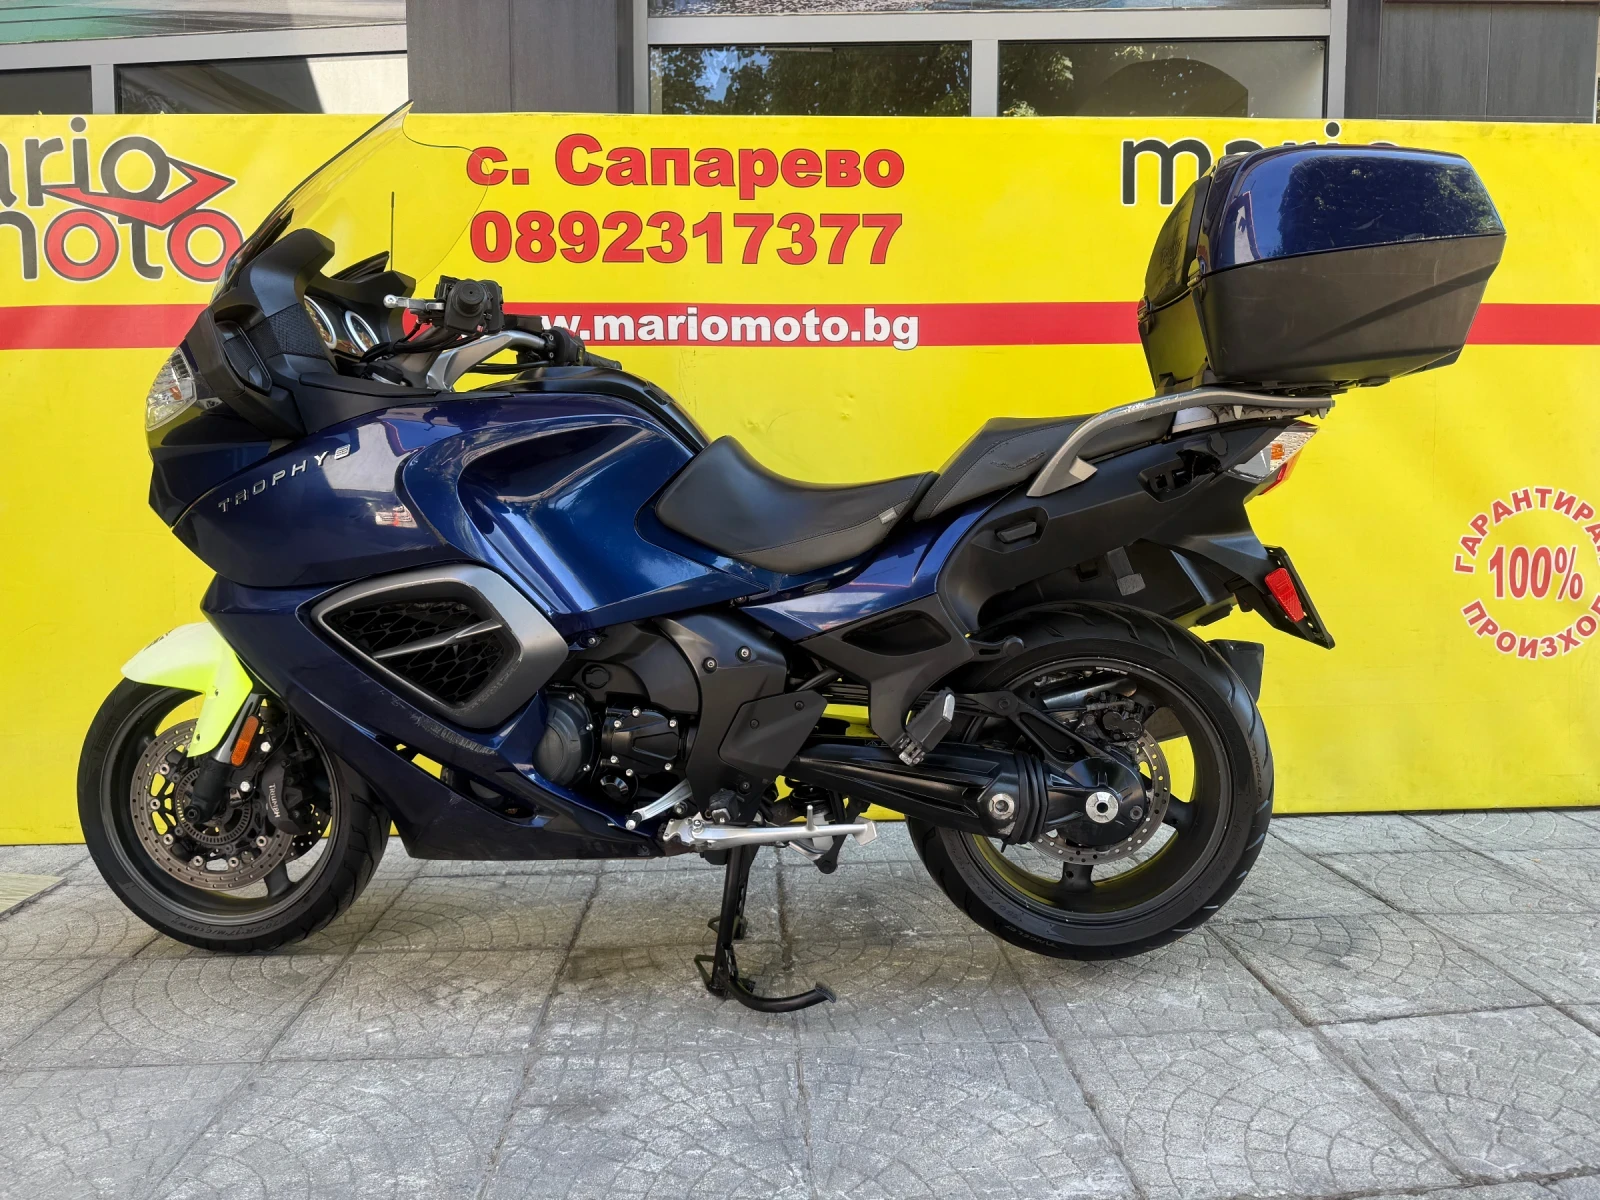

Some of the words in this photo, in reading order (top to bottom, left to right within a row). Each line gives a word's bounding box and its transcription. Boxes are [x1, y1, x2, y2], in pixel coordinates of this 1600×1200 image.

[466, 146, 530, 186] с.
[554, 133, 905, 200] Сапарево
[470, 211, 903, 265] 0892317377
[541, 307, 919, 350] w.mariomoto.bg
[218, 450, 330, 513] TROPHY
[1454, 487, 1600, 573] ГАРАНТИРА
[1489, 546, 1583, 600] 100%
[1462, 595, 1600, 659] ПРОИЗХО
[268, 782, 281, 818] TRIUMPH
